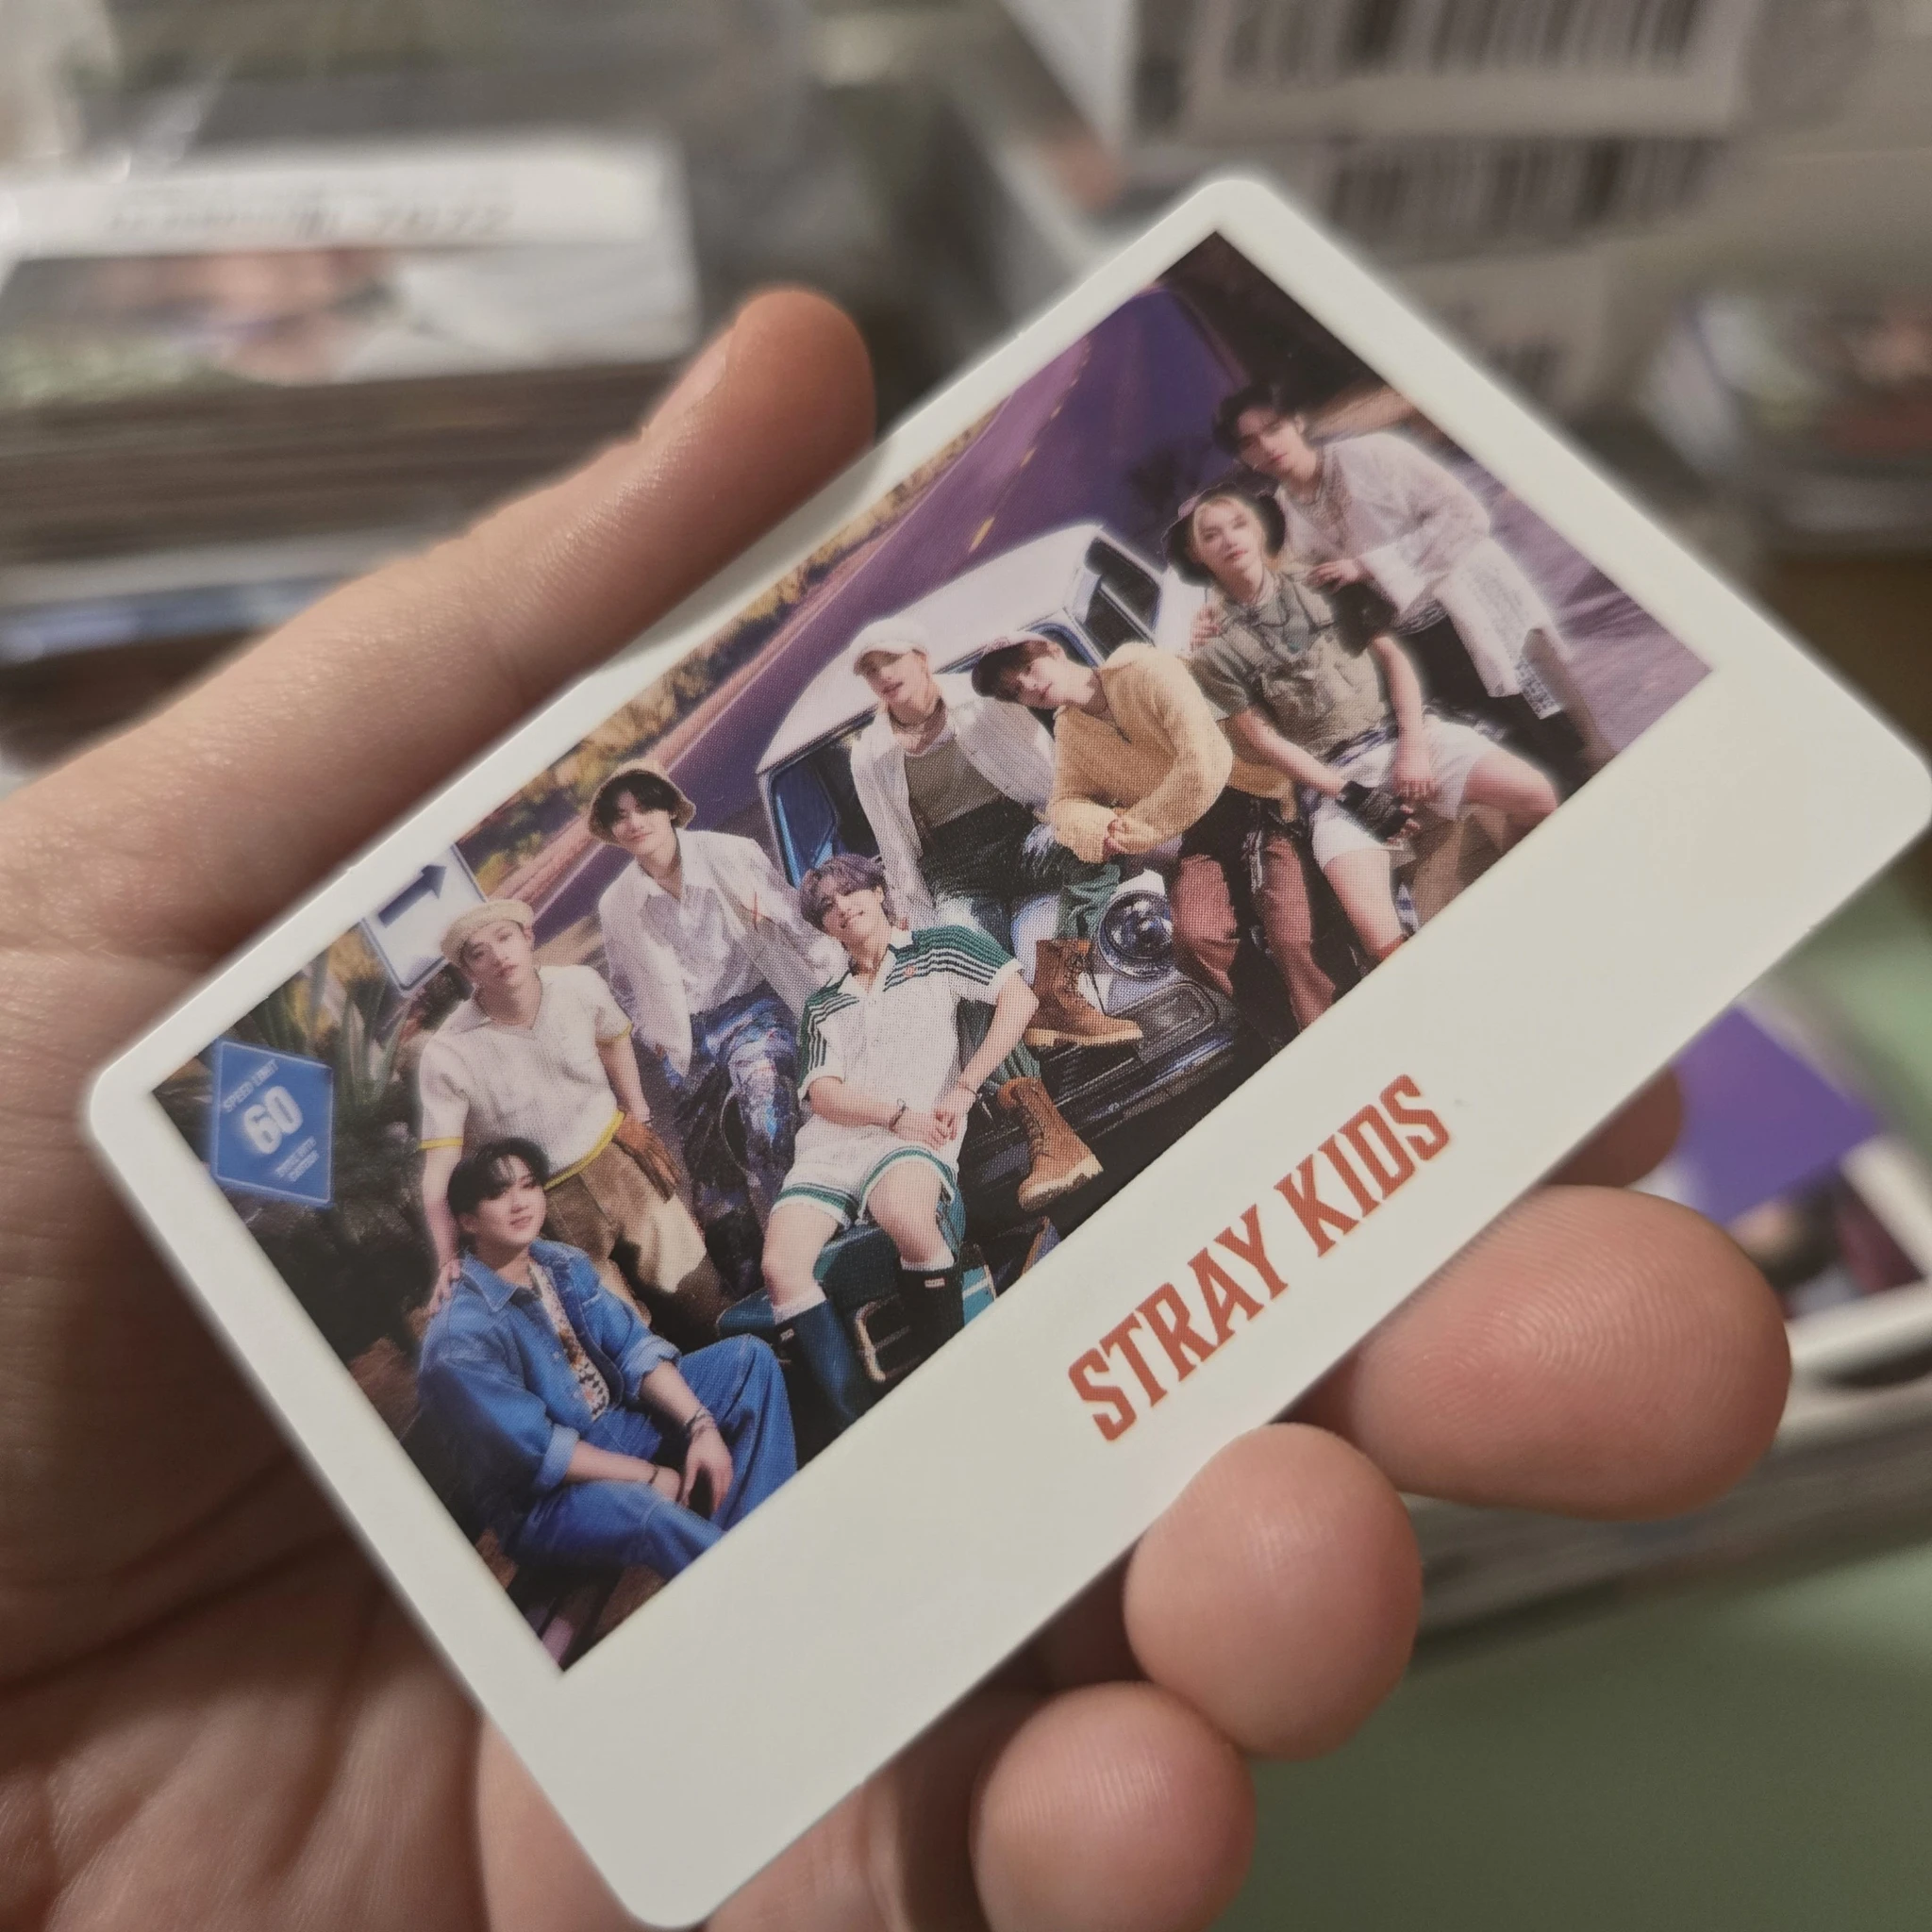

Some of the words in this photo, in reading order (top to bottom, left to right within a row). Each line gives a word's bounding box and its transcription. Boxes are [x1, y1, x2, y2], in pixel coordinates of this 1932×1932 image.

[243, 1086, 303, 1155] 60
[1068, 1203, 1289, 1442] STRAY
[1273, 1074, 1450, 1258] KIDS
